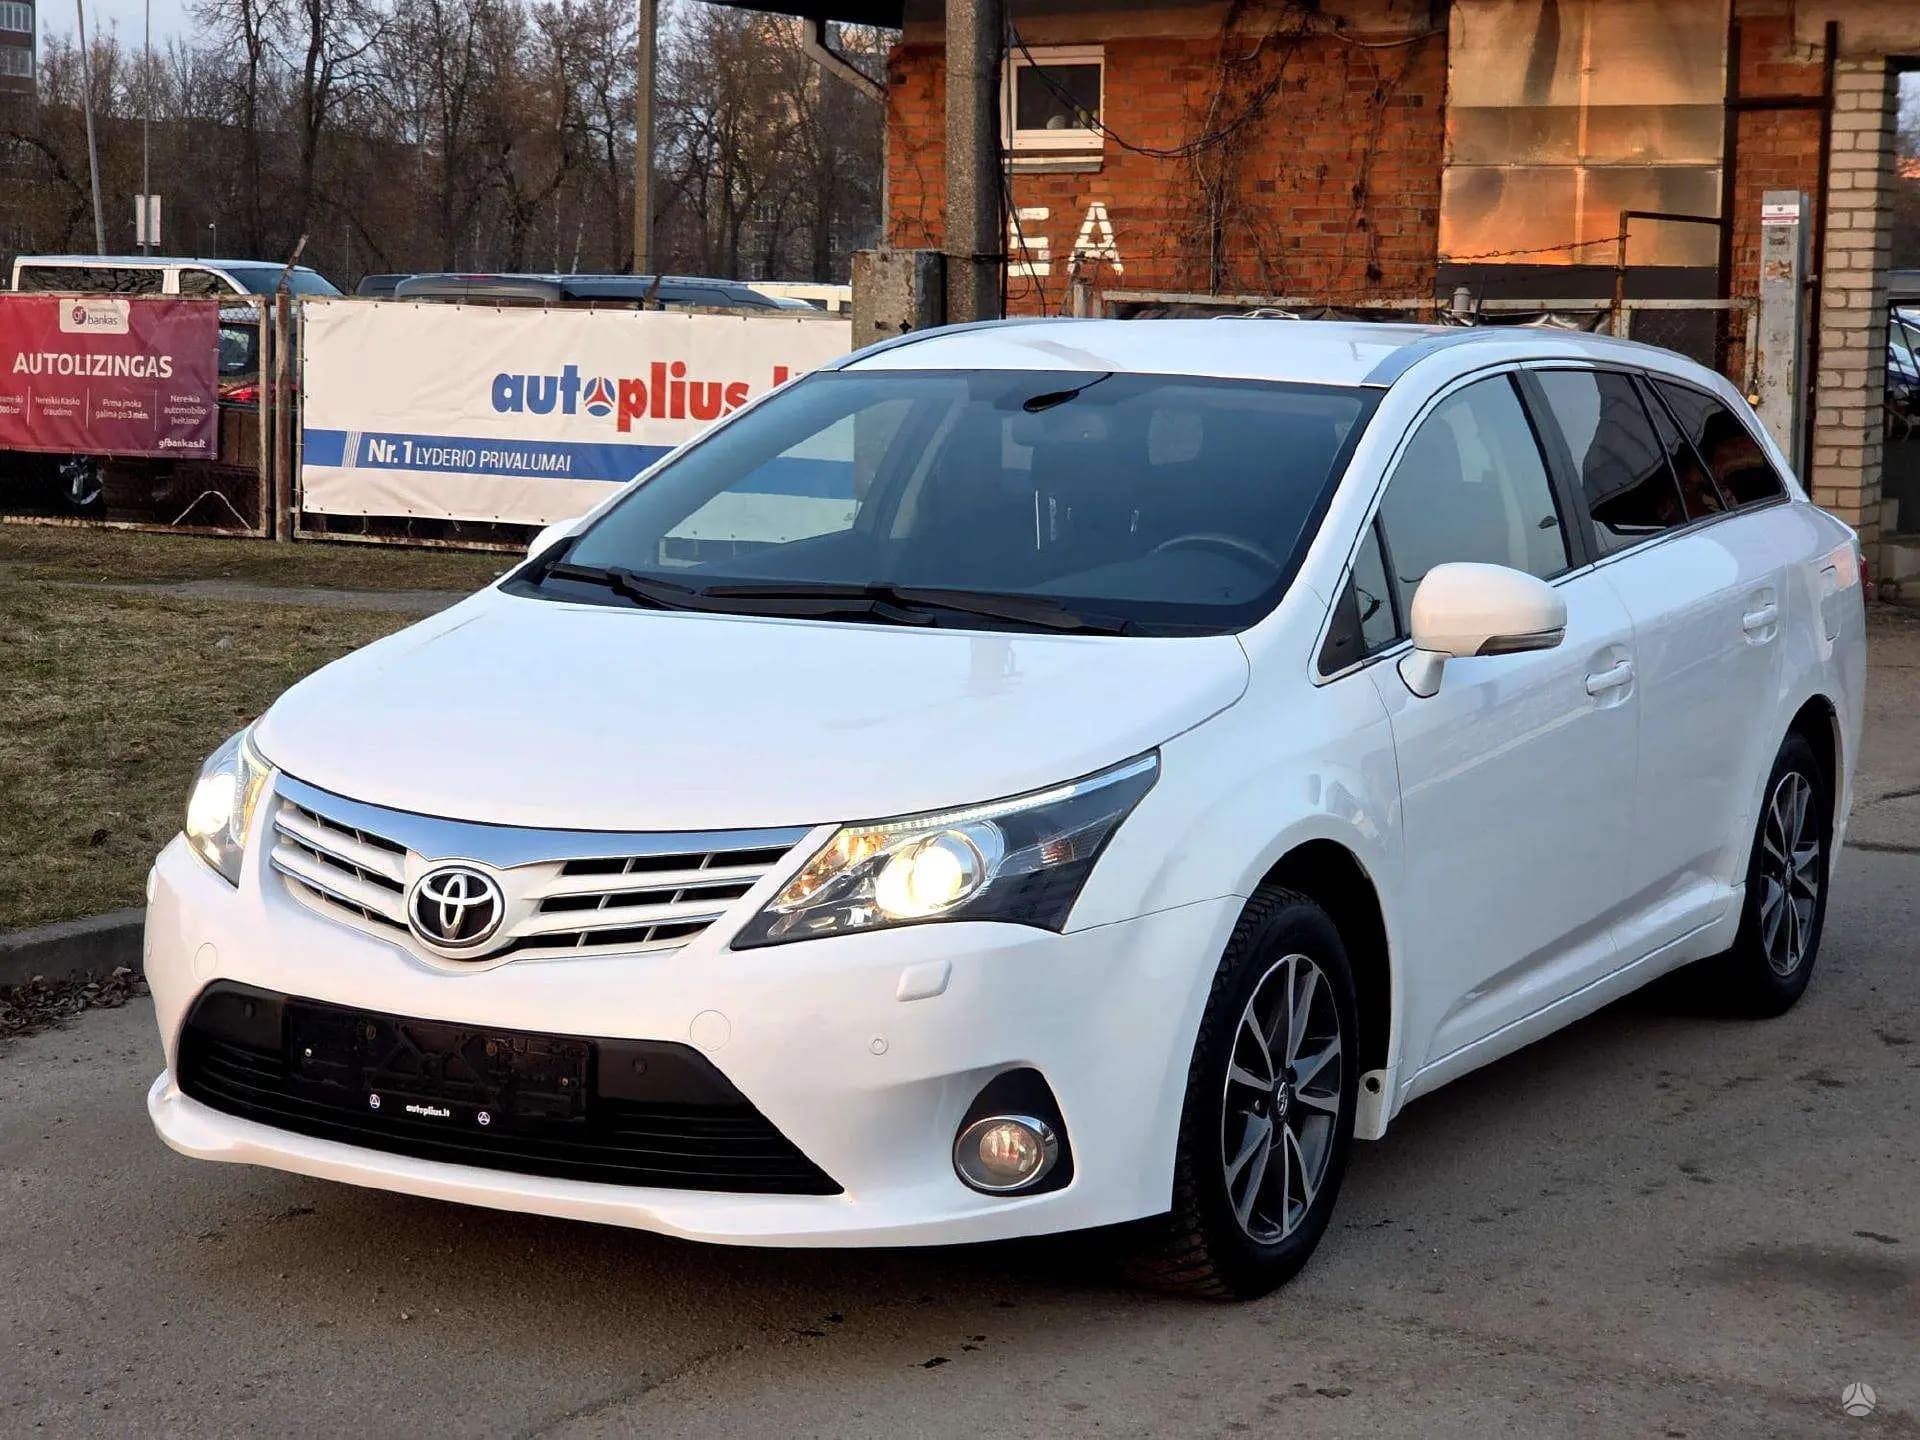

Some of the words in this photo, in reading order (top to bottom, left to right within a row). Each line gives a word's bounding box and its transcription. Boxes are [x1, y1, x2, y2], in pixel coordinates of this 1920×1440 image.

[88, 314, 118, 325] bankas
[13, 352, 173, 378] AUTOLIZINGAS
[491, 361, 803, 432] autoplius
[368, 439, 398, 464] Nr.
[403, 440, 413, 464] 1
[415, 447, 476, 468] LYDERIO
[479, 450, 571, 472] PRIVALUMAI
